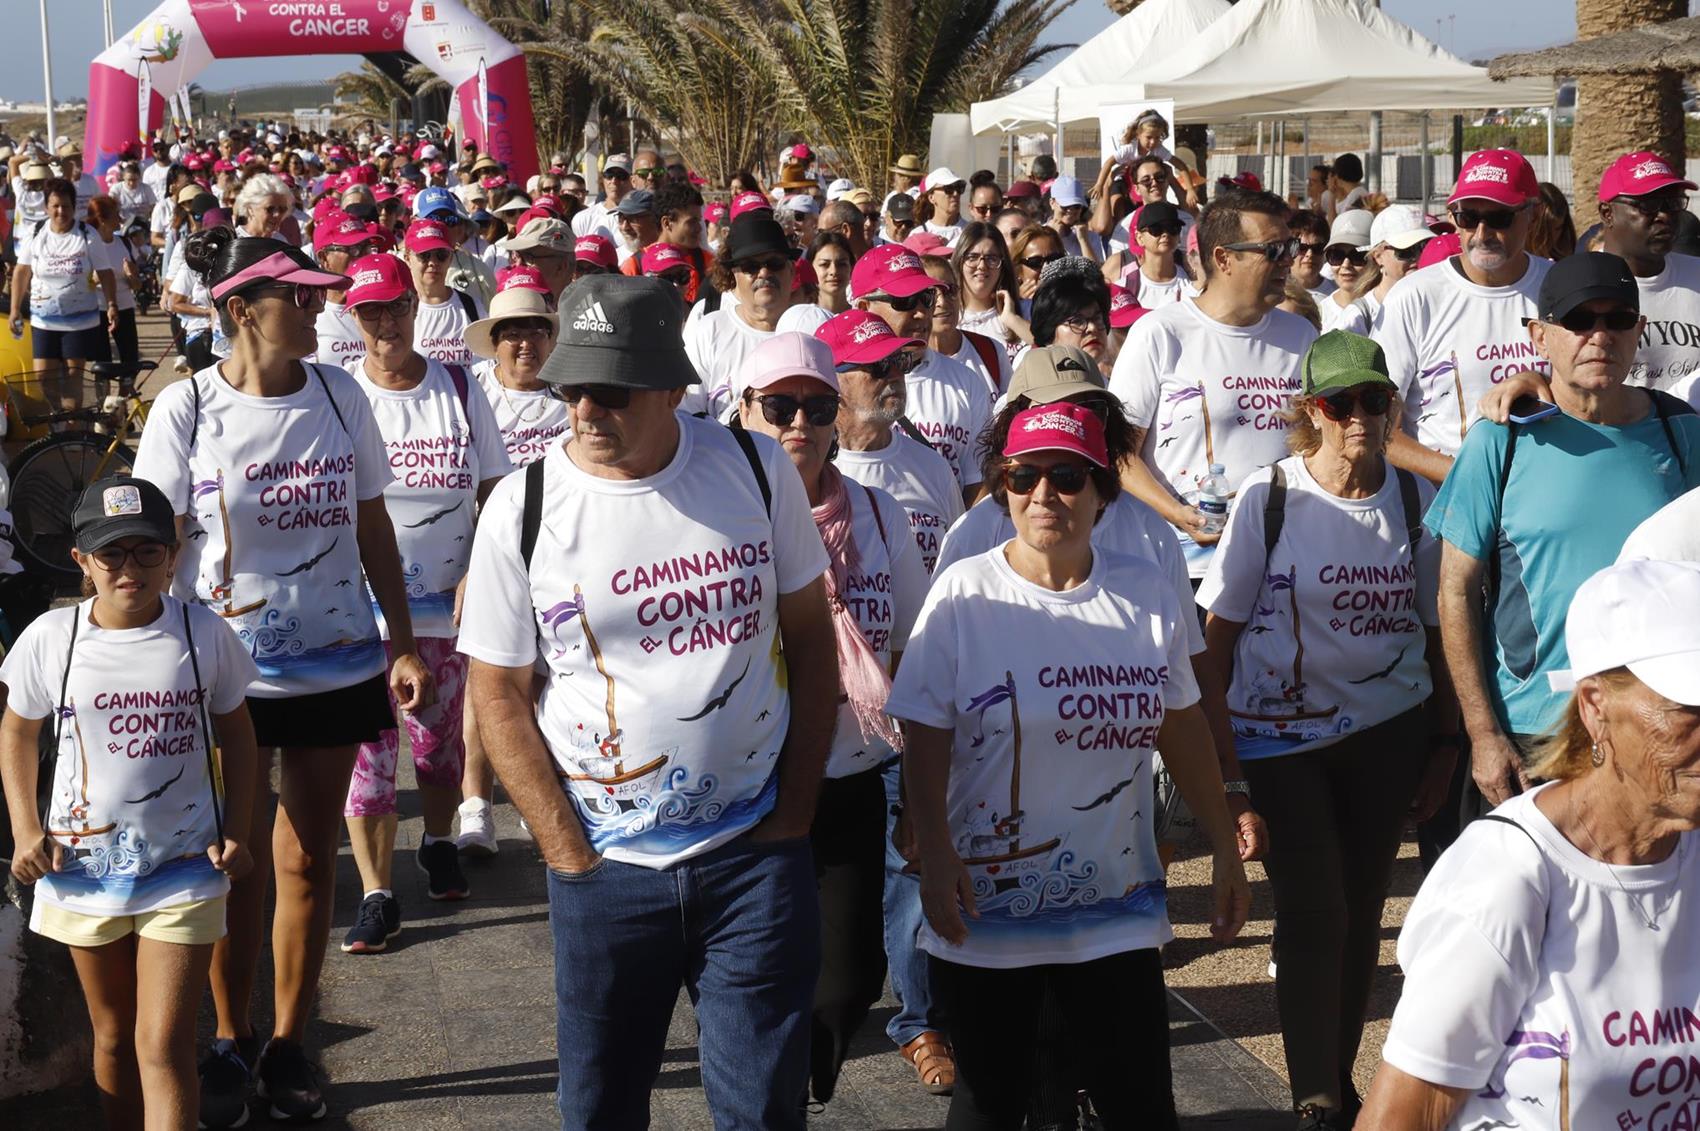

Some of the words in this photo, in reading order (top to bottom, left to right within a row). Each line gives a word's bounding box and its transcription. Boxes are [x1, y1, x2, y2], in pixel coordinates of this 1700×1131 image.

[269, 3, 325, 16] CONTRA
[329, 5, 346, 16] EL
[289, 19, 370, 36] CANCER
[572, 319, 614, 333] adidas
[428, 350, 473, 362] CONTR
[1476, 341, 1539, 361] CAMIN
[1490, 361, 1552, 384] CONT
[1237, 394, 1292, 410] CONT
[1236, 415, 1251, 426] EL
[245, 453, 354, 481] CAMINAMOS
[389, 452, 469, 468] CONTRA
[259, 480, 347, 507] CONTRA
[256, 514, 275, 527] EL
[611, 540, 770, 595] CAMINAMOS
[637, 575, 762, 626] CONTRA
[1333, 588, 1415, 612] CONTR
[1329, 616, 1347, 632] EL
[639, 635, 663, 654] EL
[1038, 665, 1169, 688] CAMINAMOS
[1058, 692, 1162, 720] CONTRA
[109, 711, 197, 735] CONTRA
[1054, 728, 1075, 745] EL
[107, 741, 123, 754] EL
[618, 782, 647, 796] AFOL
[1005, 861, 1037, 874] AFOL
[1603, 1007, 1700, 1047] CAMIN
[1616, 1109, 1643, 1131] EL
